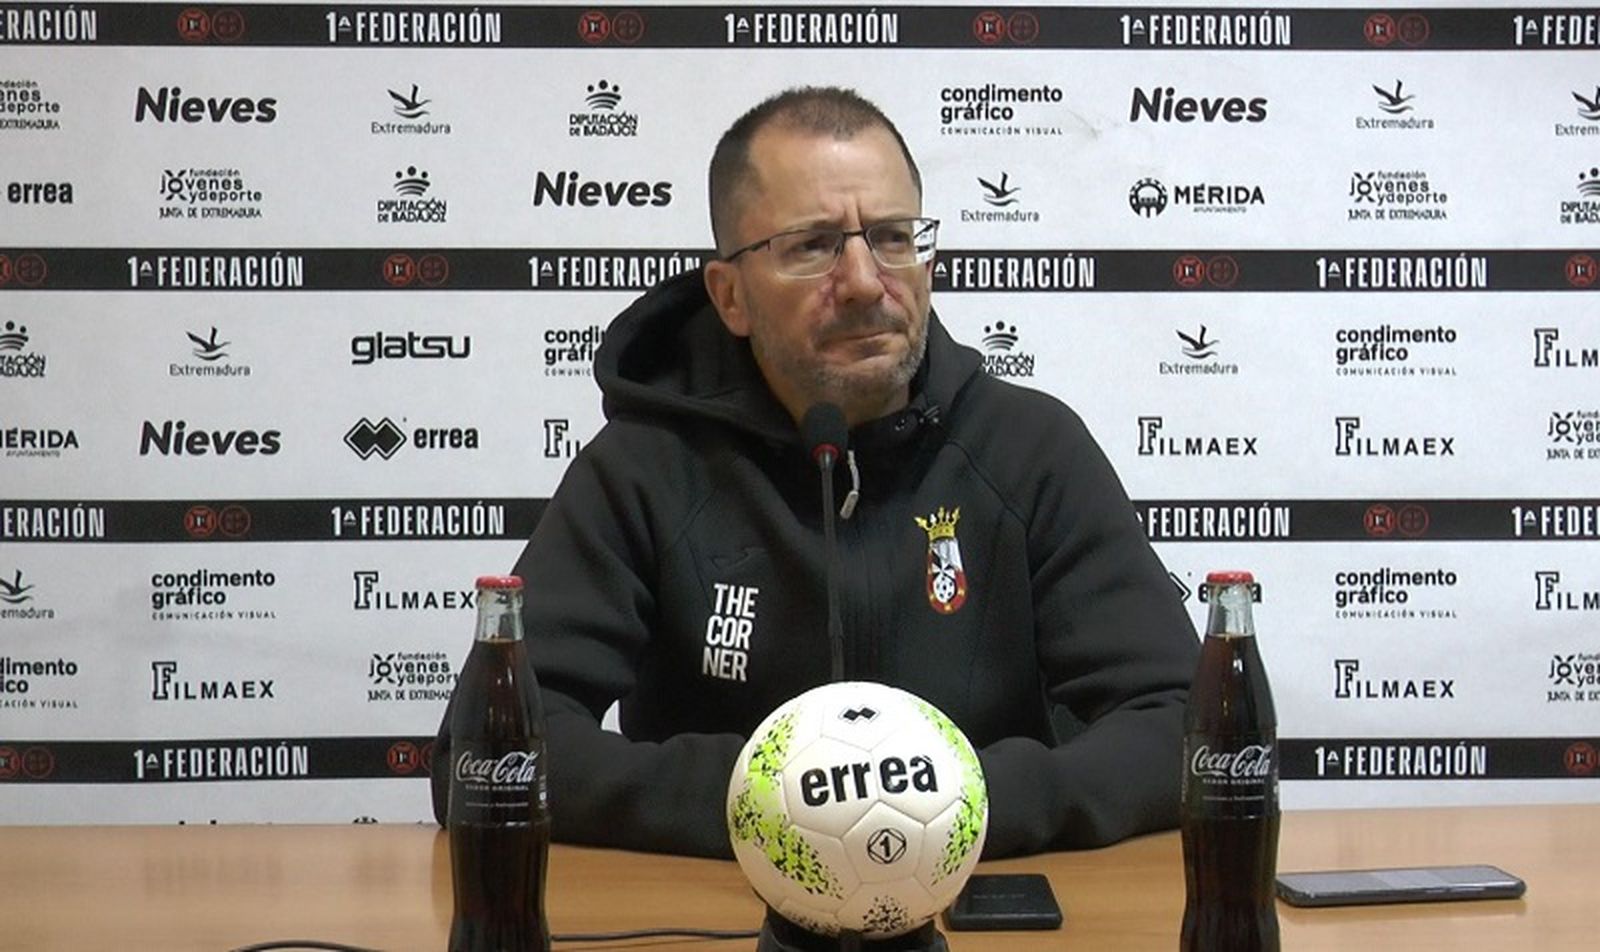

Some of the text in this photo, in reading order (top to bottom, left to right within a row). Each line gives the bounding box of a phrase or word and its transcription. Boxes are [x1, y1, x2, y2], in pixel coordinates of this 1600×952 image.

[356, 8, 501, 43] FEDERACIÓN
[754, 8, 897, 43] FEDERACIÓN
[1149, 10, 1291, 45] FEDERACIÓN
[1543, 15, 1600, 45] FEDE
[941, 84, 1062, 102] condimento
[135, 87, 277, 124] Nieves
[941, 101, 1014, 125] gráfico
[1129, 87, 1268, 123] Nieves
[371, 121, 451, 135] Extremadura
[570, 111, 638, 126] DIPUTACIÓN
[583, 124, 638, 136] BADAJOZ
[1356, 117, 1434, 130] Extremadura
[941, 126, 1063, 135] COMUNICACIÓN VISUAL
[189, 168, 240, 177] fundación
[1377, 170, 1426, 179] fundación
[7, 181, 73, 204] errea
[534, 171, 672, 207] Nieves
[1174, 183, 1265, 205] MÉRIDA
[159, 207, 262, 219] JUNTA DE EXTREMADURA
[378, 197, 447, 211] DIPUTACIÓN
[961, 209, 1039, 222] Extremadura
[1348, 209, 1447, 221] JUNTA DE EXTREMADURA
[391, 211, 446, 223] BADAJOZ
[157, 252, 303, 287] FEDERACIÓN
[952, 253, 1095, 288] FEDERACIÓN
[1345, 253, 1487, 288] FEDERACIÓN
[1336, 325, 1457, 344] condimento
[352, 331, 470, 365] glatsu
[1336, 343, 1409, 365] gráfico
[169, 364, 250, 376] Extremadura
[1159, 362, 1238, 375] Extremadura
[1336, 366, 1457, 376] COMUNICACIÓN VISUAL
[139, 420, 281, 457] Nieves
[413, 427, 479, 449] errea
[1138, 417, 1258, 455] FILMAEX
[1335, 417, 1455, 456] FILMAEX
[1547, 448, 1571, 460] JUNTA
[1573, 449, 1584, 459] DE
[3, 503, 105, 537] ERACIÓN
[361, 501, 505, 536] FEDERACIÓN
[1148, 502, 1290, 537] FEDERACIÓN
[1541, 506, 1600, 536] FEDE
[152, 569, 275, 587] condimento
[1335, 568, 1457, 586] condimento
[152, 587, 226, 609] gráfico
[354, 571, 475, 610] FILMAEX
[714, 583, 759, 618] THE
[1335, 586, 1408, 608] gráfico
[152, 610, 276, 620] COMUNICACIÓN VISUAL
[1335, 609, 1415, 618] COMUNICACIÓN
[705, 615, 753, 650] COR
[702, 647, 748, 682] NER
[152, 661, 274, 700] FILMAEX
[1335, 659, 1455, 698] FILMAEX
[40, 700, 78, 709] VISUAL
[368, 690, 392, 702] JUNTA
[396, 690, 405, 700] DE
[163, 742, 308, 778] FEDERACIÓN
[455, 751, 538, 783] Coca-Cola
[1191, 745, 1273, 777] Coca-Cola
[1344, 741, 1486, 776] FEDERACIÓN
[800, 754, 938, 807] errea
[879, 836, 891, 857] 1
